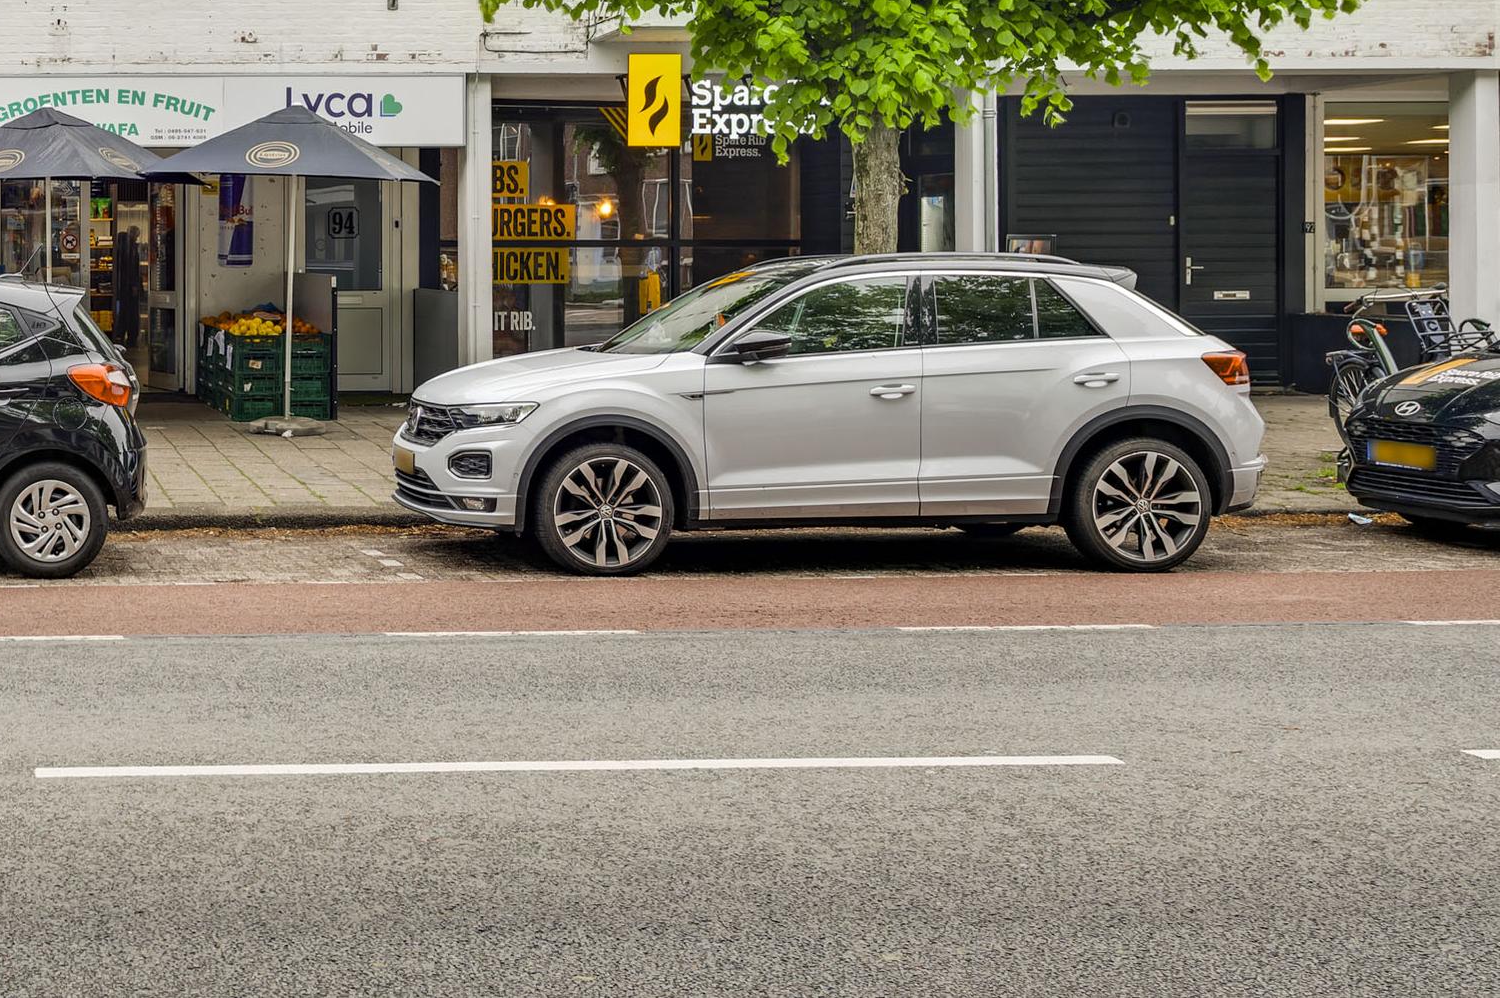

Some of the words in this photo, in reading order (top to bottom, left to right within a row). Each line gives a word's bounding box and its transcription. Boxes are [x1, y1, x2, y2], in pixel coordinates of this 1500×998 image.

[117, 89, 146, 106] EN
[152, 93, 215, 122] FRUIT
[96, 123, 139, 136] AFA
[333, 121, 373, 134] obile
[692, 108, 816, 139] Expre
[715, 135, 747, 147] Spare
[748, 135, 766, 145] Rib
[715, 146, 761, 158] Express.
[492, 165, 524, 194] BS.
[332, 212, 355, 234] 94
[492, 208, 571, 237] URGERS.
[492, 252, 565, 280] ICKEN.
[510, 312, 536, 330] RIB.
